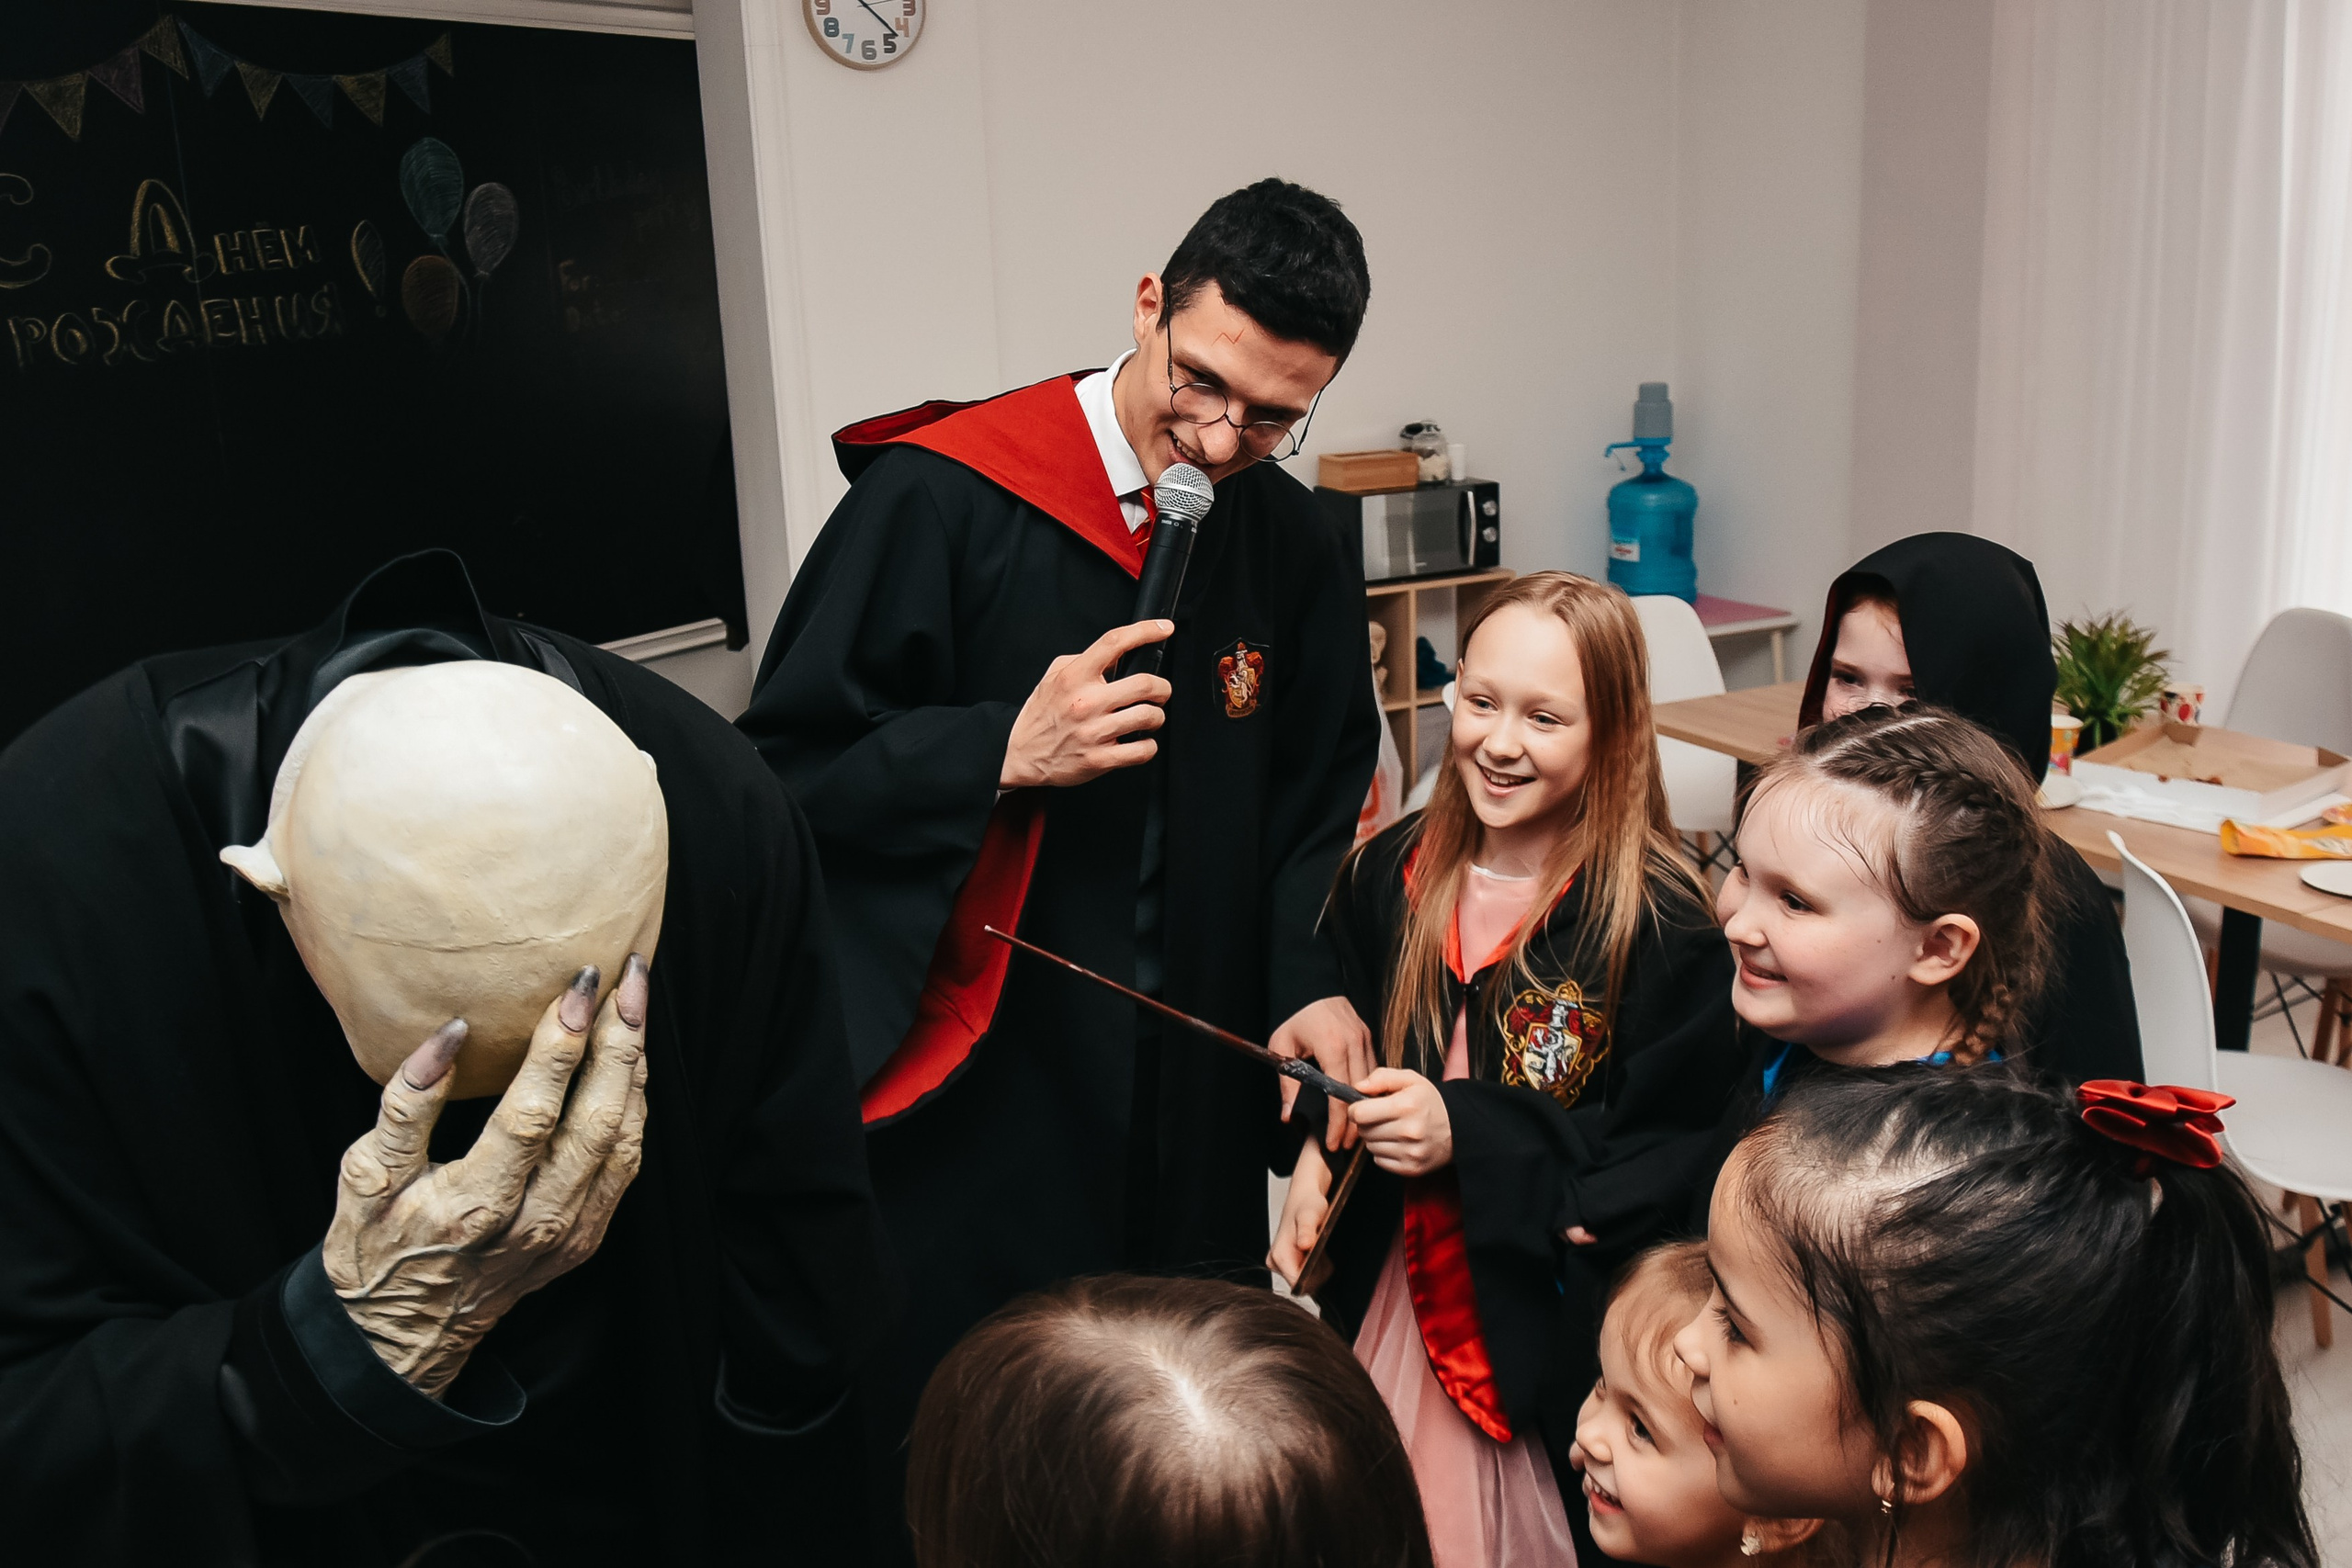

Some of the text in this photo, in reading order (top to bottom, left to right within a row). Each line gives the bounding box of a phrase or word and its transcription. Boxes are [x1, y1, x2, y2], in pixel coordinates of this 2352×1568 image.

[823, 17, 840, 38] 8
[895, 17, 910, 38] 4
[842, 34, 854, 53] 7
[861, 40, 876, 60] 6
[883, 34, 898, 53] 5
[7, 281, 345, 367] РОЖДЕНИЯ
